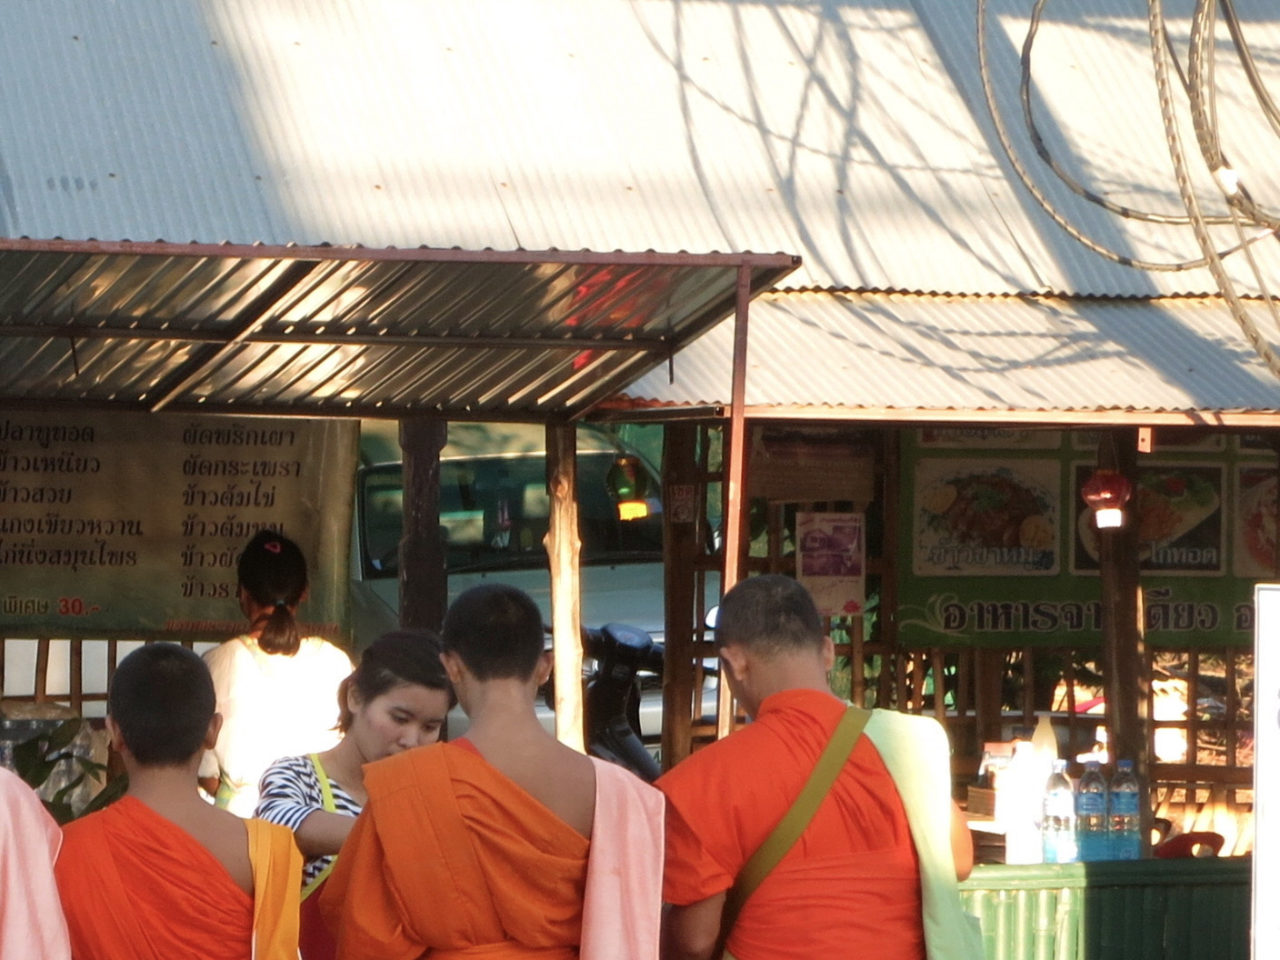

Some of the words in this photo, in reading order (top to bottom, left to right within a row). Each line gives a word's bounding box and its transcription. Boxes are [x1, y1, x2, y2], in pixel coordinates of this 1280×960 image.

[182, 423, 296, 447] ผัดพริกเผา
[182, 453, 302, 479] ผัดกระเพรา
[182, 479, 277, 507] ข้าวต้มไข่
[3, 595, 50, 616] พิเศษ
